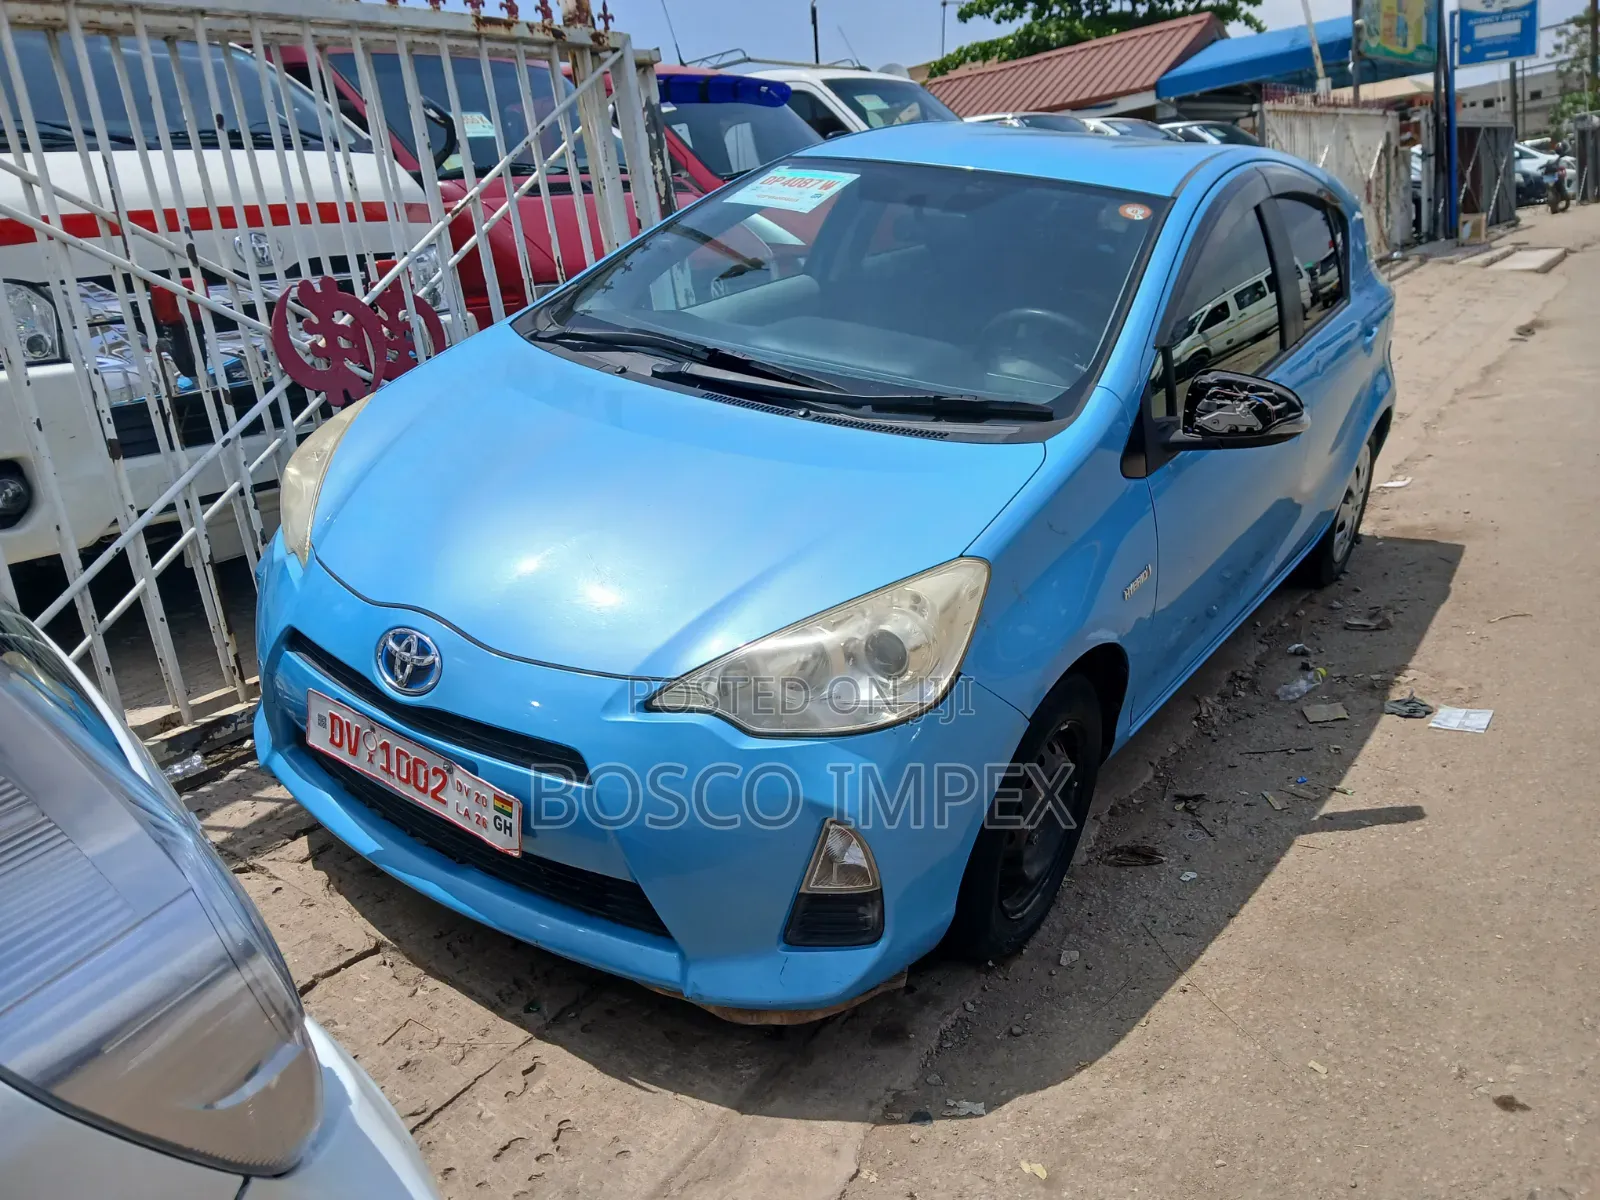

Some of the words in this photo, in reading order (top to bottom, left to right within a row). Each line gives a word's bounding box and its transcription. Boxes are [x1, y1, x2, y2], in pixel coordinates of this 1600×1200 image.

[329, 711, 360, 756] DV
[379, 740, 448, 805] 1002
[456, 778, 472, 798] DV
[474, 790, 488, 808] 20
[455, 800, 471, 822] LA
[493, 814, 513, 838] GH
